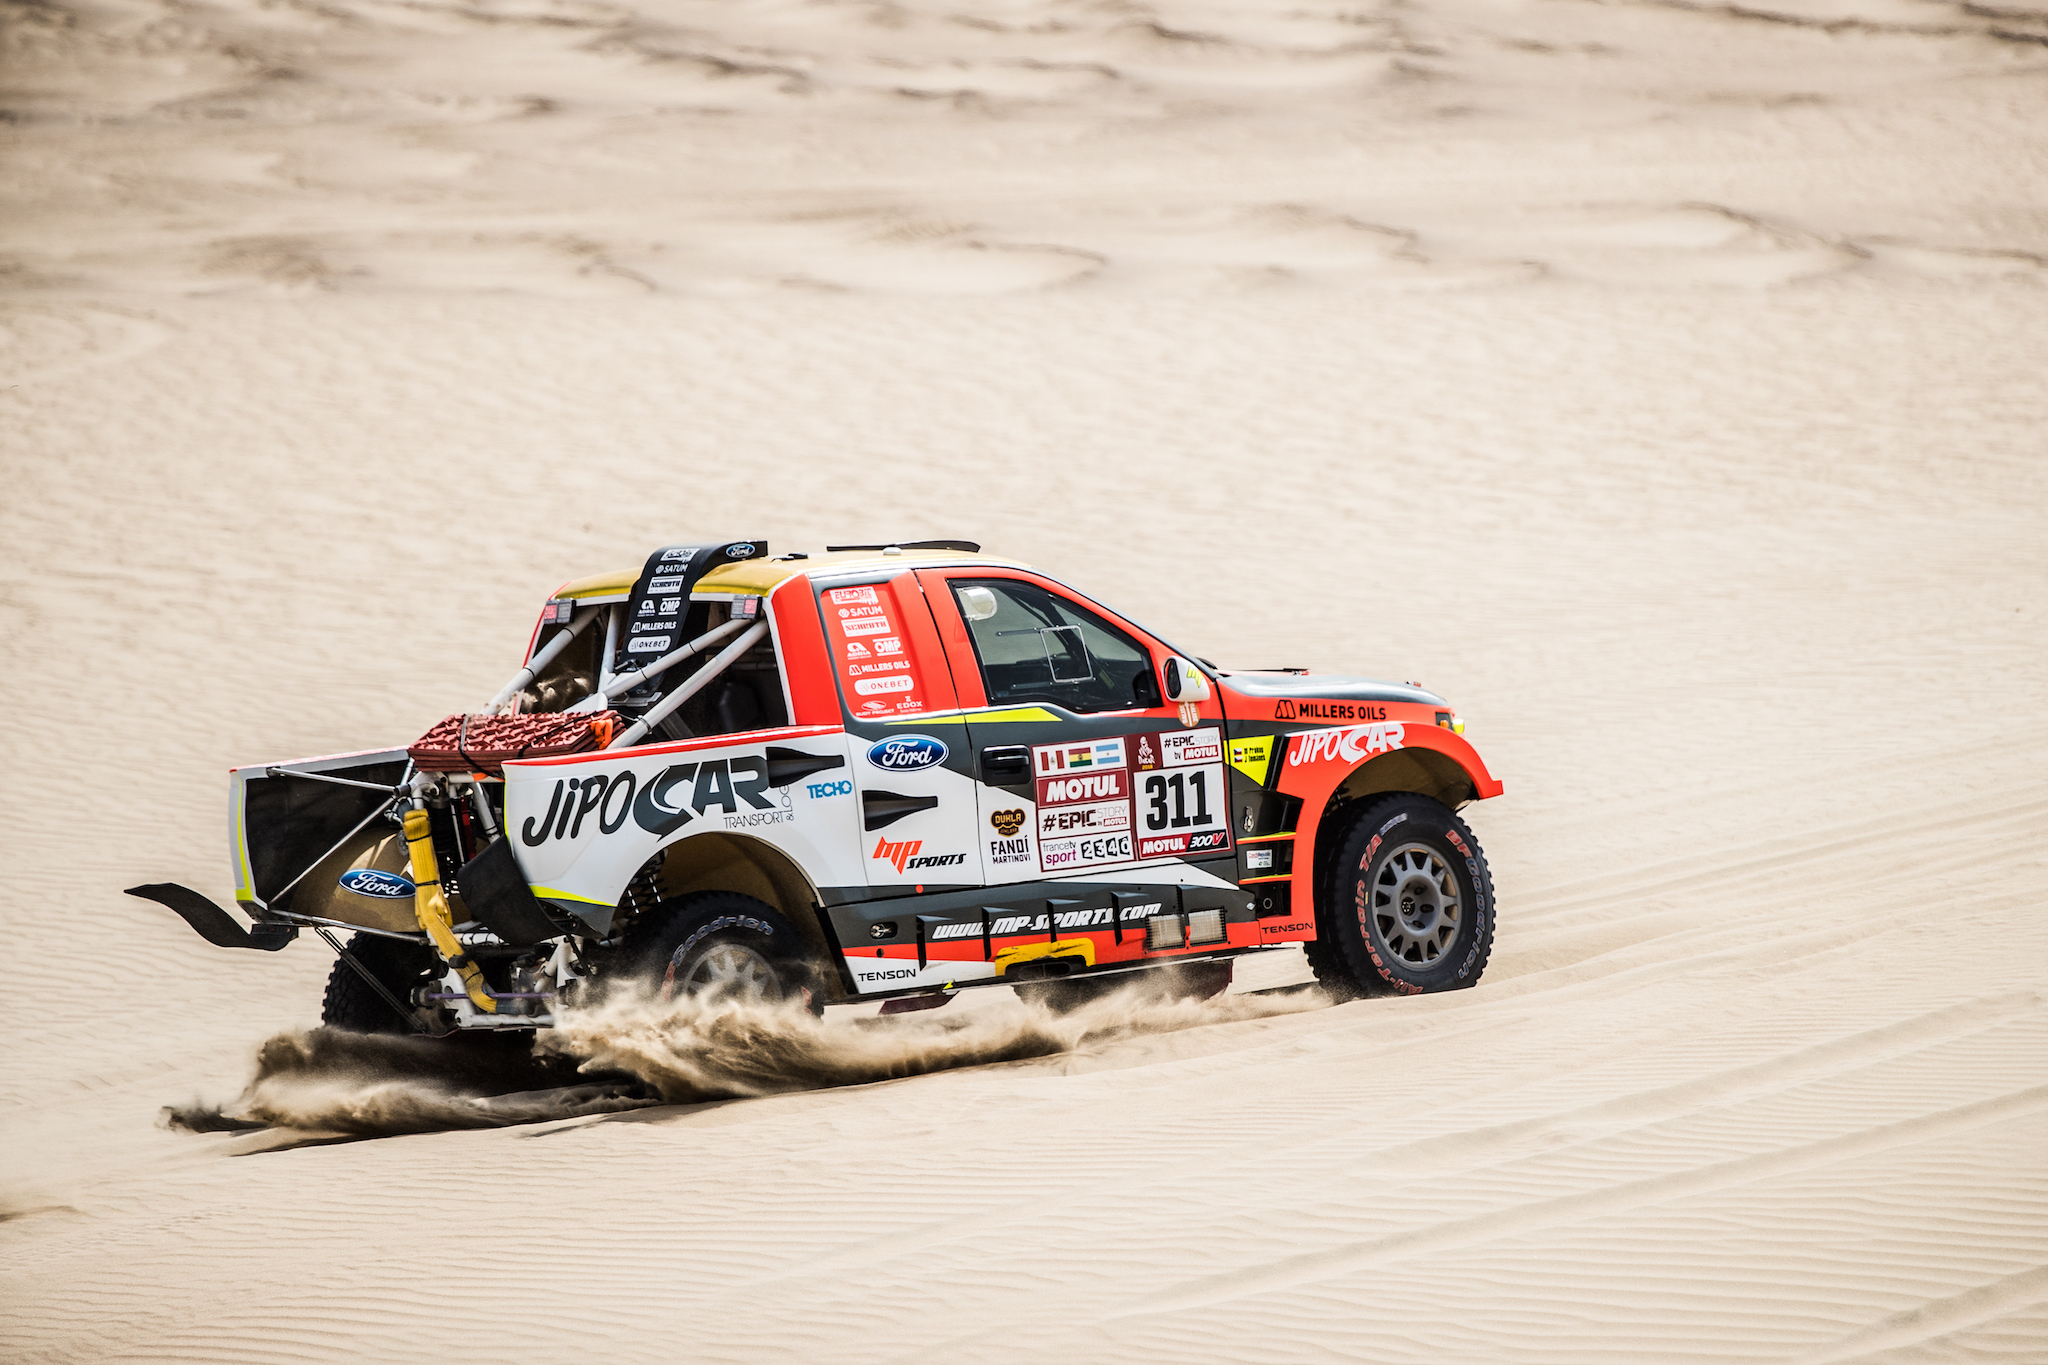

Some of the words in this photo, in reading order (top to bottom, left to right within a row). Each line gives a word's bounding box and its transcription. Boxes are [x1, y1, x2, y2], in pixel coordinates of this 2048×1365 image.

[664, 564, 688, 573] SATUM
[660, 600, 680, 612] OMP
[850, 605, 883, 617] SATUM
[641, 621, 664, 630] MILLERS
[664, 621, 677, 629] OILS
[639, 640, 667, 648] ONEBET
[874, 640, 901, 653] OMP
[861, 662, 893, 673] MILLERS
[893, 660, 911, 670] OILS
[870, 679, 908, 690] ONEBET
[896, 701, 922, 709] EDOX
[1300, 704, 1355, 719] MILLERS
[1357, 707, 1387, 719] OILS
[881, 740, 933, 767] Ford
[1174, 751, 1181, 760] by
[1184, 746, 1218, 759] MOTUL
[807, 780, 852, 799] TECHO
[1046, 774, 1120, 803] MOTUL
[1145, 770, 1213, 831] 311
[723, 811, 785, 829] TRANSPORT
[995, 813, 1021, 824] DUKLA
[1104, 816, 1127, 827] MOTUL
[991, 834, 1029, 855] FANDÍ
[1043, 841, 1077, 852] francetv
[1142, 838, 1186, 854] MOTUL
[1189, 832, 1225, 848] 300V
[907, 853, 967, 869] SPORTS
[993, 854, 1031, 864] MARTINOVI
[1045, 849, 1077, 865] sport
[350, 872, 404, 895] Ford
[1445, 829, 1486, 979] BFGoodrich
[1262, 922, 1313, 934] TENSON
[857, 968, 917, 982] TENSON
